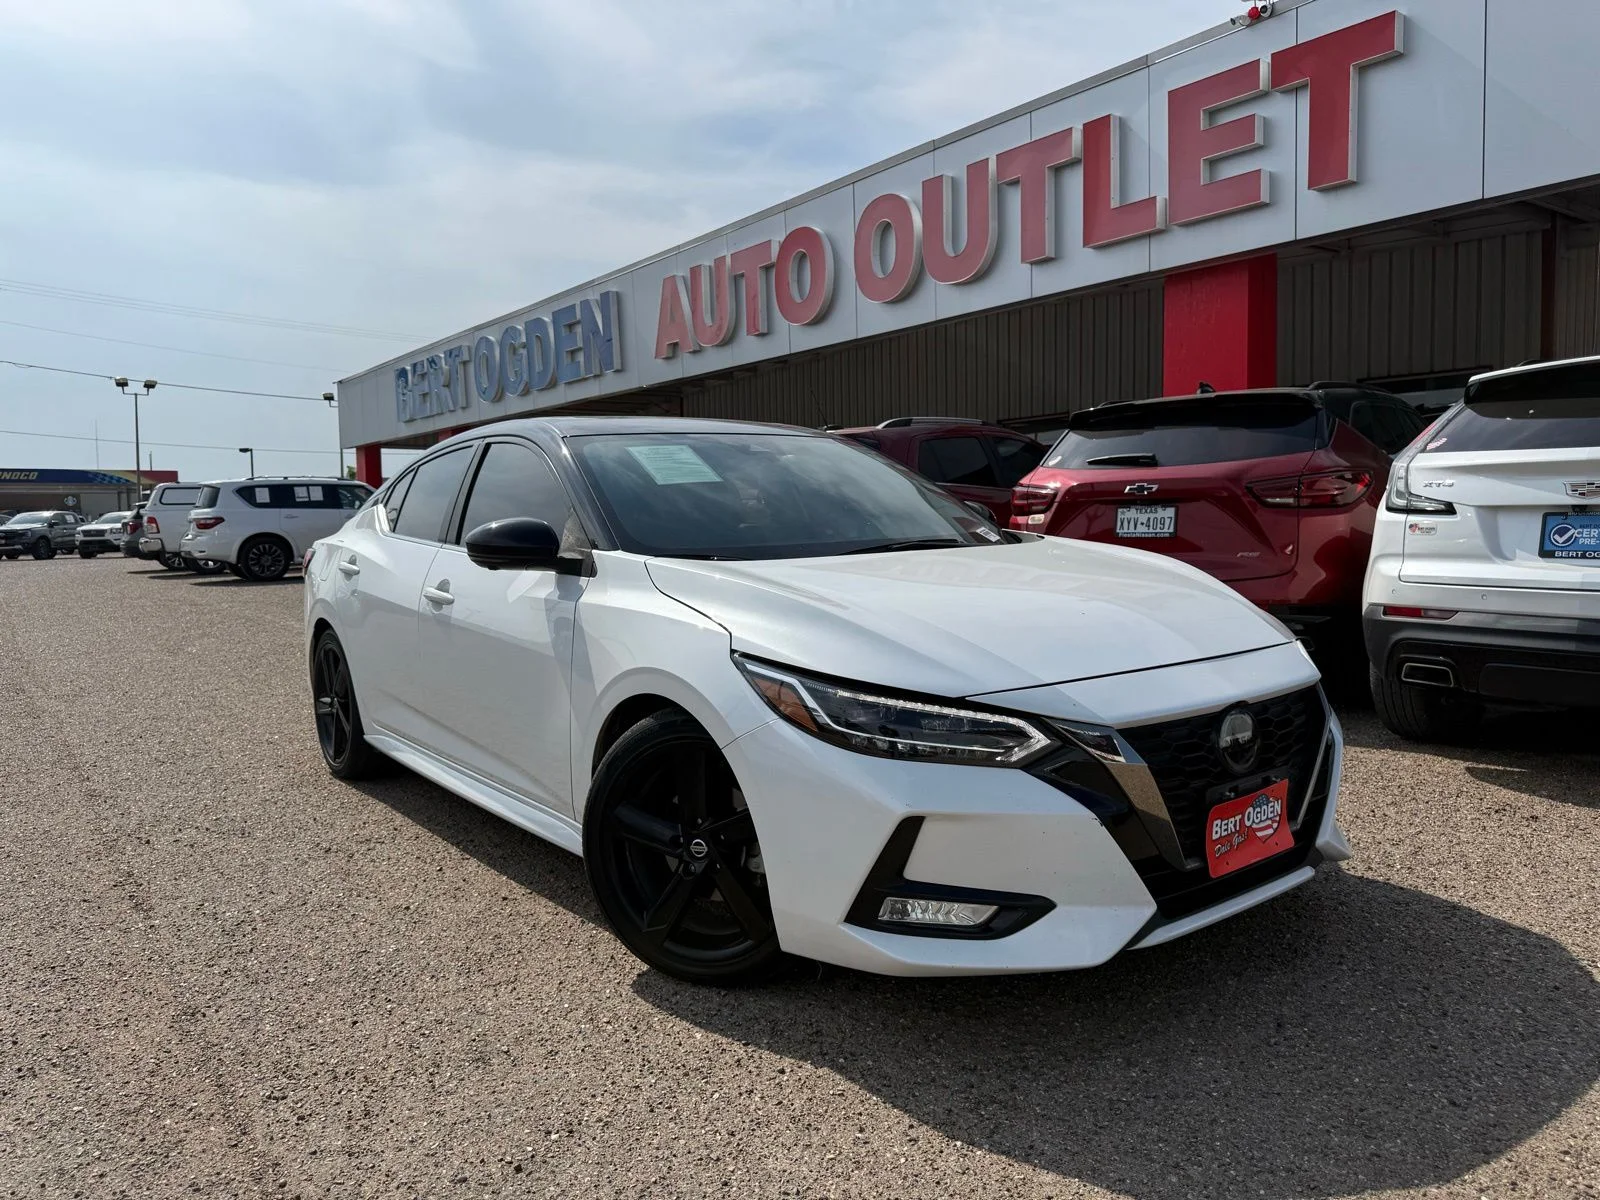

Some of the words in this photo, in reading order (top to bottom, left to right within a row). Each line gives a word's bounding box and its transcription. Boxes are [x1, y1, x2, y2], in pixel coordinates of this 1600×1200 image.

[395, 345, 470, 423] BERT
[474, 290, 622, 403] OGDEN
[654, 226, 835, 360] AUTO
[854, 9, 1404, 304] OUTLET
[0, 471, 38, 480] NOCO
[1212, 814, 1242, 840] BERT
[1244, 799, 1281, 827] OGDEN
